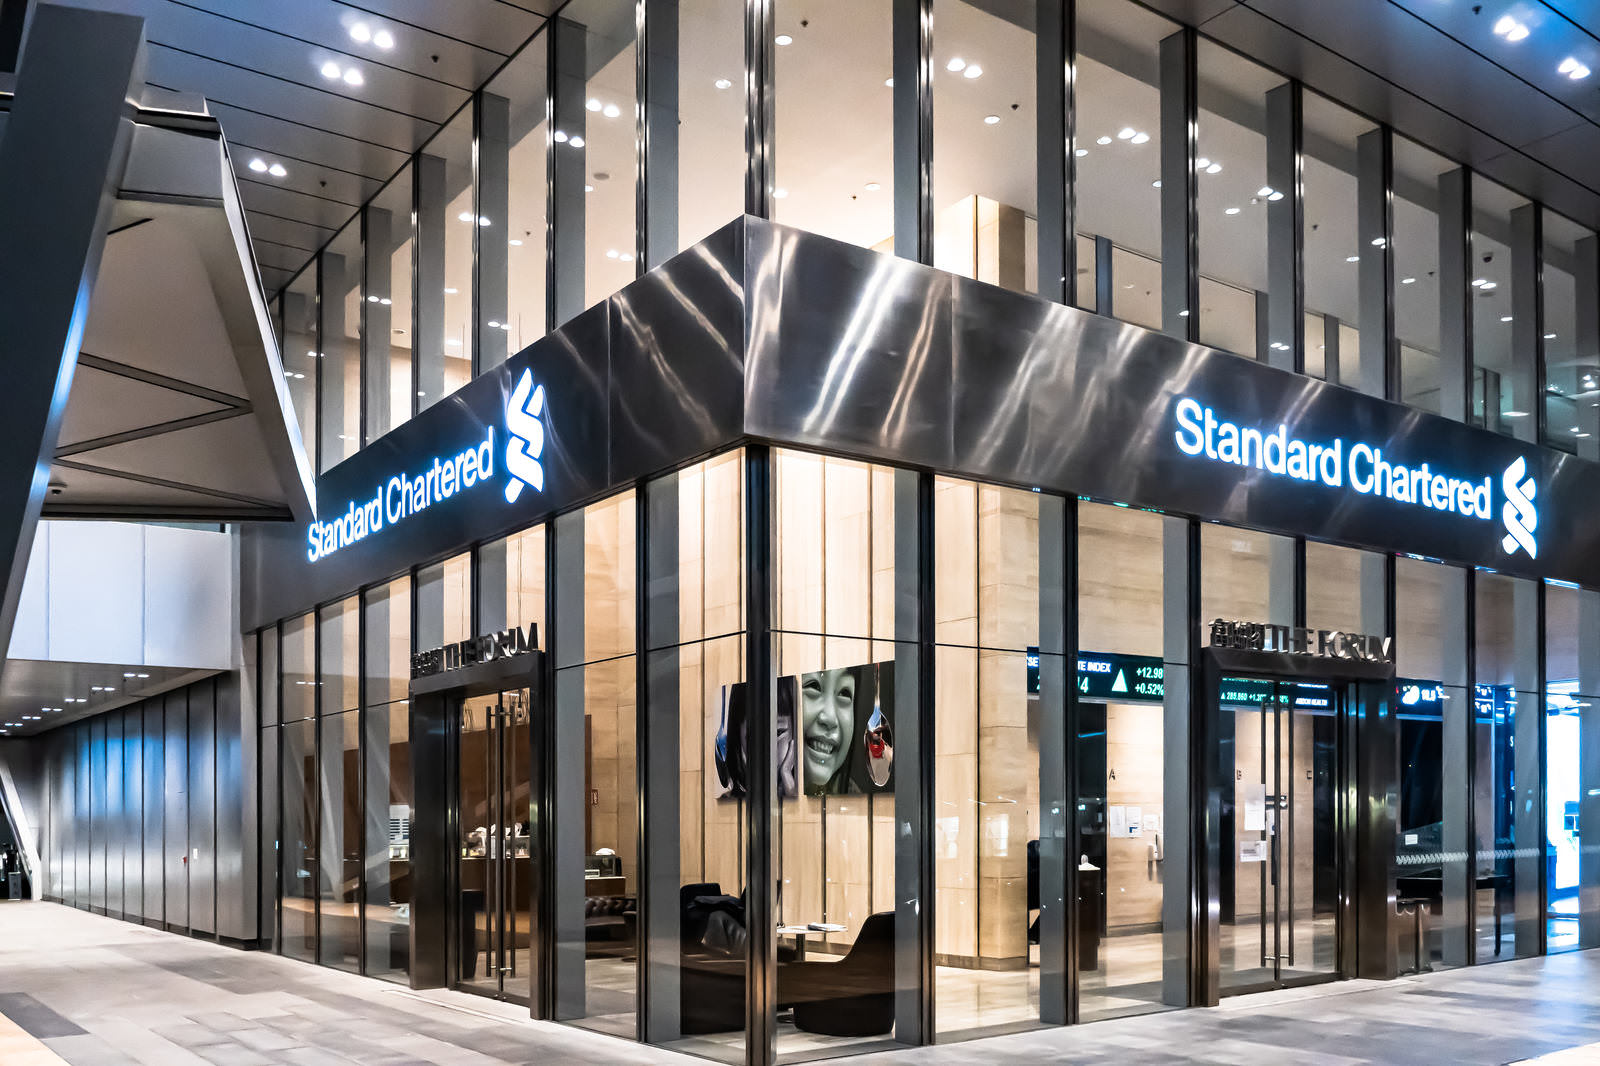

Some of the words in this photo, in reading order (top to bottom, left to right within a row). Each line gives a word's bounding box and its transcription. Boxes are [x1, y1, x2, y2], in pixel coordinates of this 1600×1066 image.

[1174, 398, 1342, 487] Standard
[1348, 443, 1492, 521] Chartered
[307, 486, 383, 563] Standard
[385, 425, 494, 524] Chartered
[1087, 661, 1111, 673] INDEX
[1136, 667, 1163, 679] +12.98
[1135, 683, 1164, 696] +0.52%
